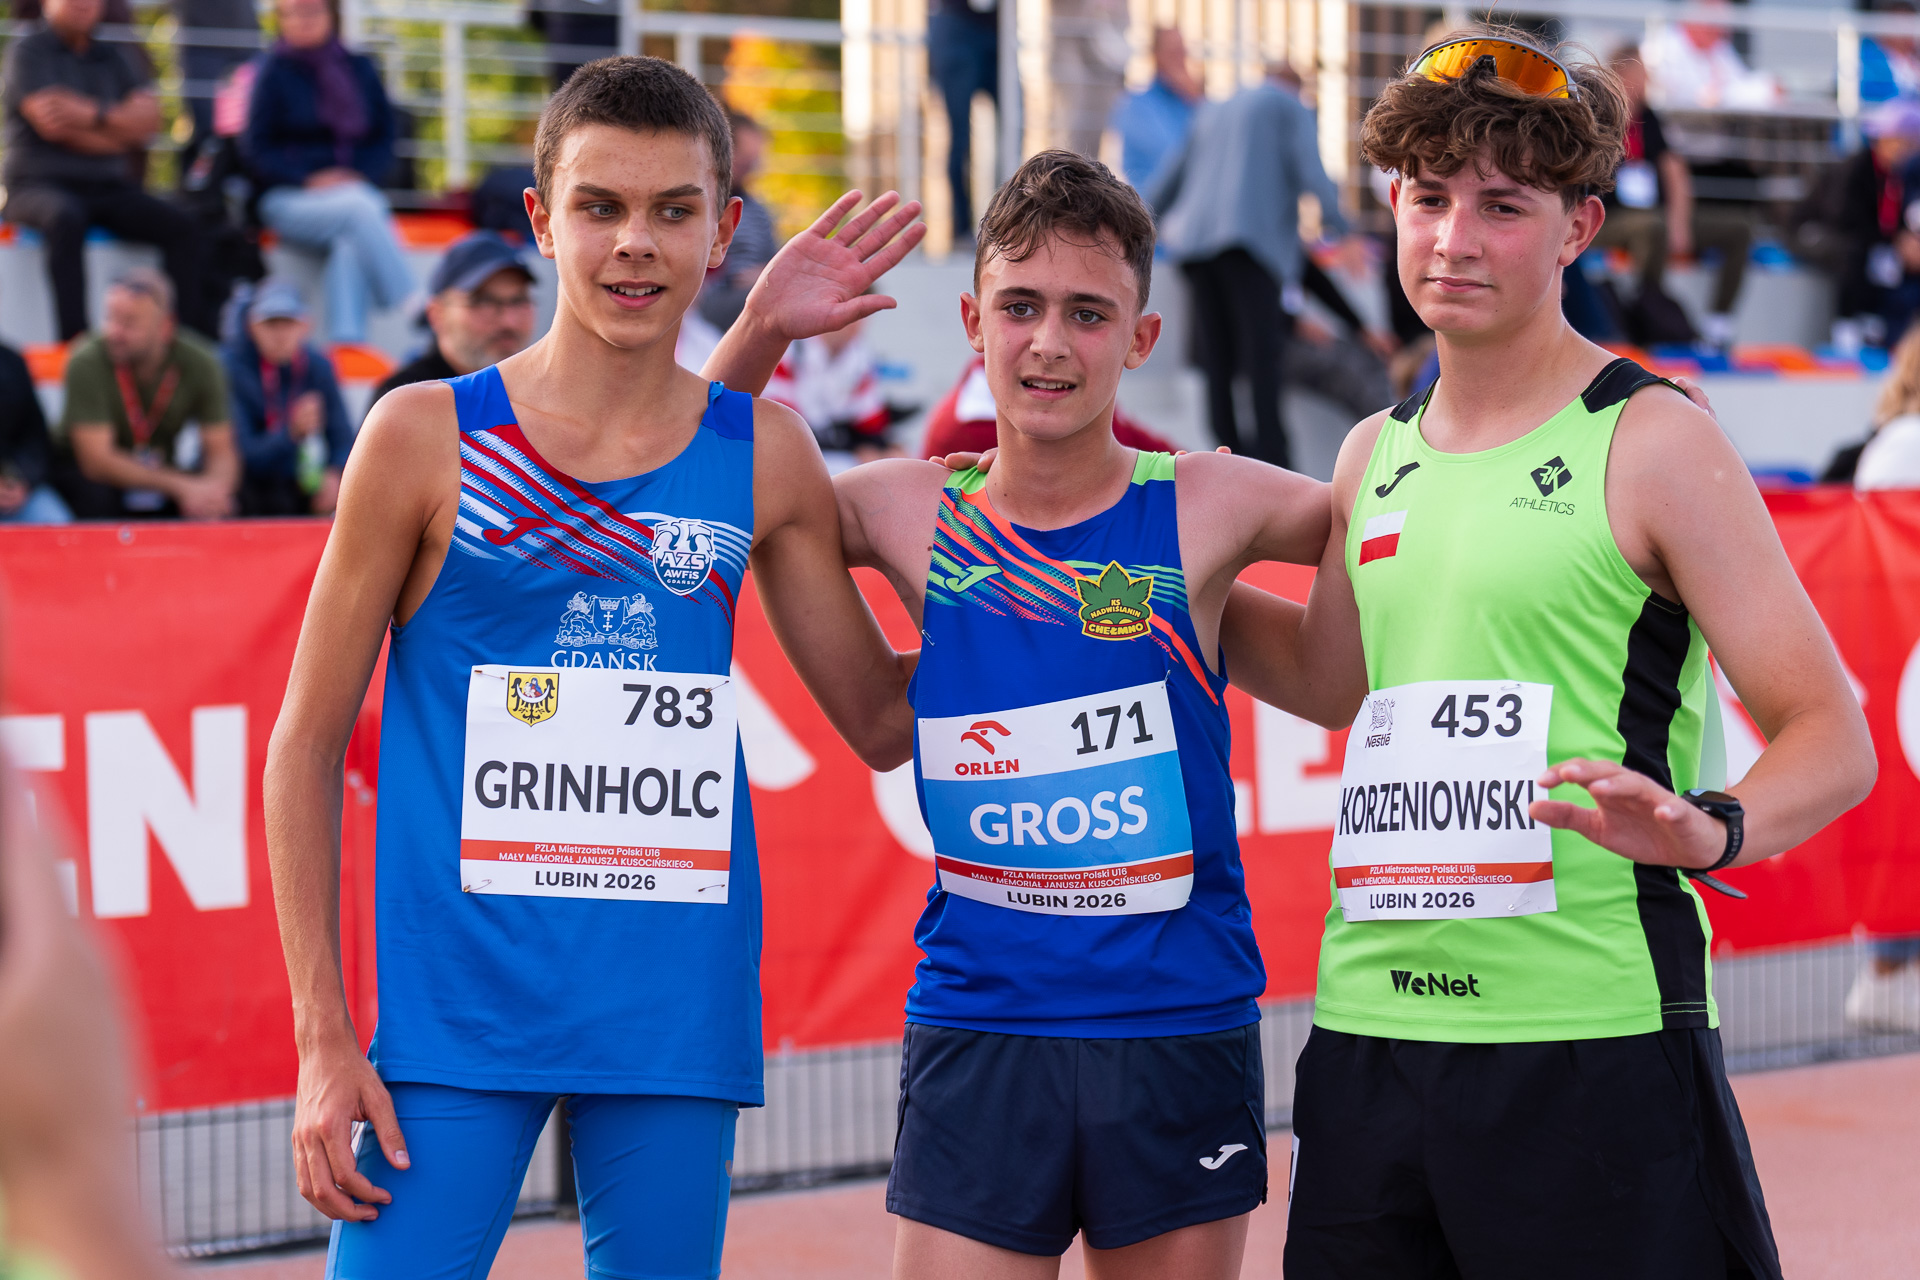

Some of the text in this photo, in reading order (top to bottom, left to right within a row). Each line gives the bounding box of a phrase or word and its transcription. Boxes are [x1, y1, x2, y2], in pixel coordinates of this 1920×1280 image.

[1509, 497, 1575, 516] ATHLETICS
[660, 552, 705, 570] AZS
[664, 569, 699, 579] AWFiS
[1090, 606, 1141, 619] NADWIŚLANIN
[1088, 623, 1143, 635] CHEŁMNO
[550, 648, 658, 671] GDAŃSK
[622, 683, 713, 729] 783
[1430, 693, 1523, 738] 453
[1070, 700, 1153, 756] 171
[954, 758, 1020, 776] ORLEN
[474, 760, 722, 819] GRINHOLC
[969, 785, 1148, 846] GROSS
[1338, 779, 1535, 836] KORZENIOWSKI
[534, 844, 660, 857] PZLA Mistrzostwa Polski U16
[498, 852, 694, 869] MAŁY MEMORIAŁ JANUSZA KUSOCIŃSKIEGO
[1003, 868, 1128, 880] PZLA Mistrzostwa Polski U16
[1369, 865, 1476, 875] PZLA Mistrzostwa Polski U16
[535, 871, 656, 890] LUBIN 2026
[996, 876, 1042, 888] MEMORIAŁ
[1044, 880, 1086, 889] JANUSZA
[1088, 872, 1162, 888] KUSOCIŃSKIEGO
[1351, 873, 1513, 886] MAŁY MEMORIAŁ JANUSZA KUSOCIŃSKIEGO
[1007, 891, 1126, 909] LUBIN 2026
[1370, 891, 1475, 909] LUBIN 2026
[1390, 969, 1480, 997] WeNet
